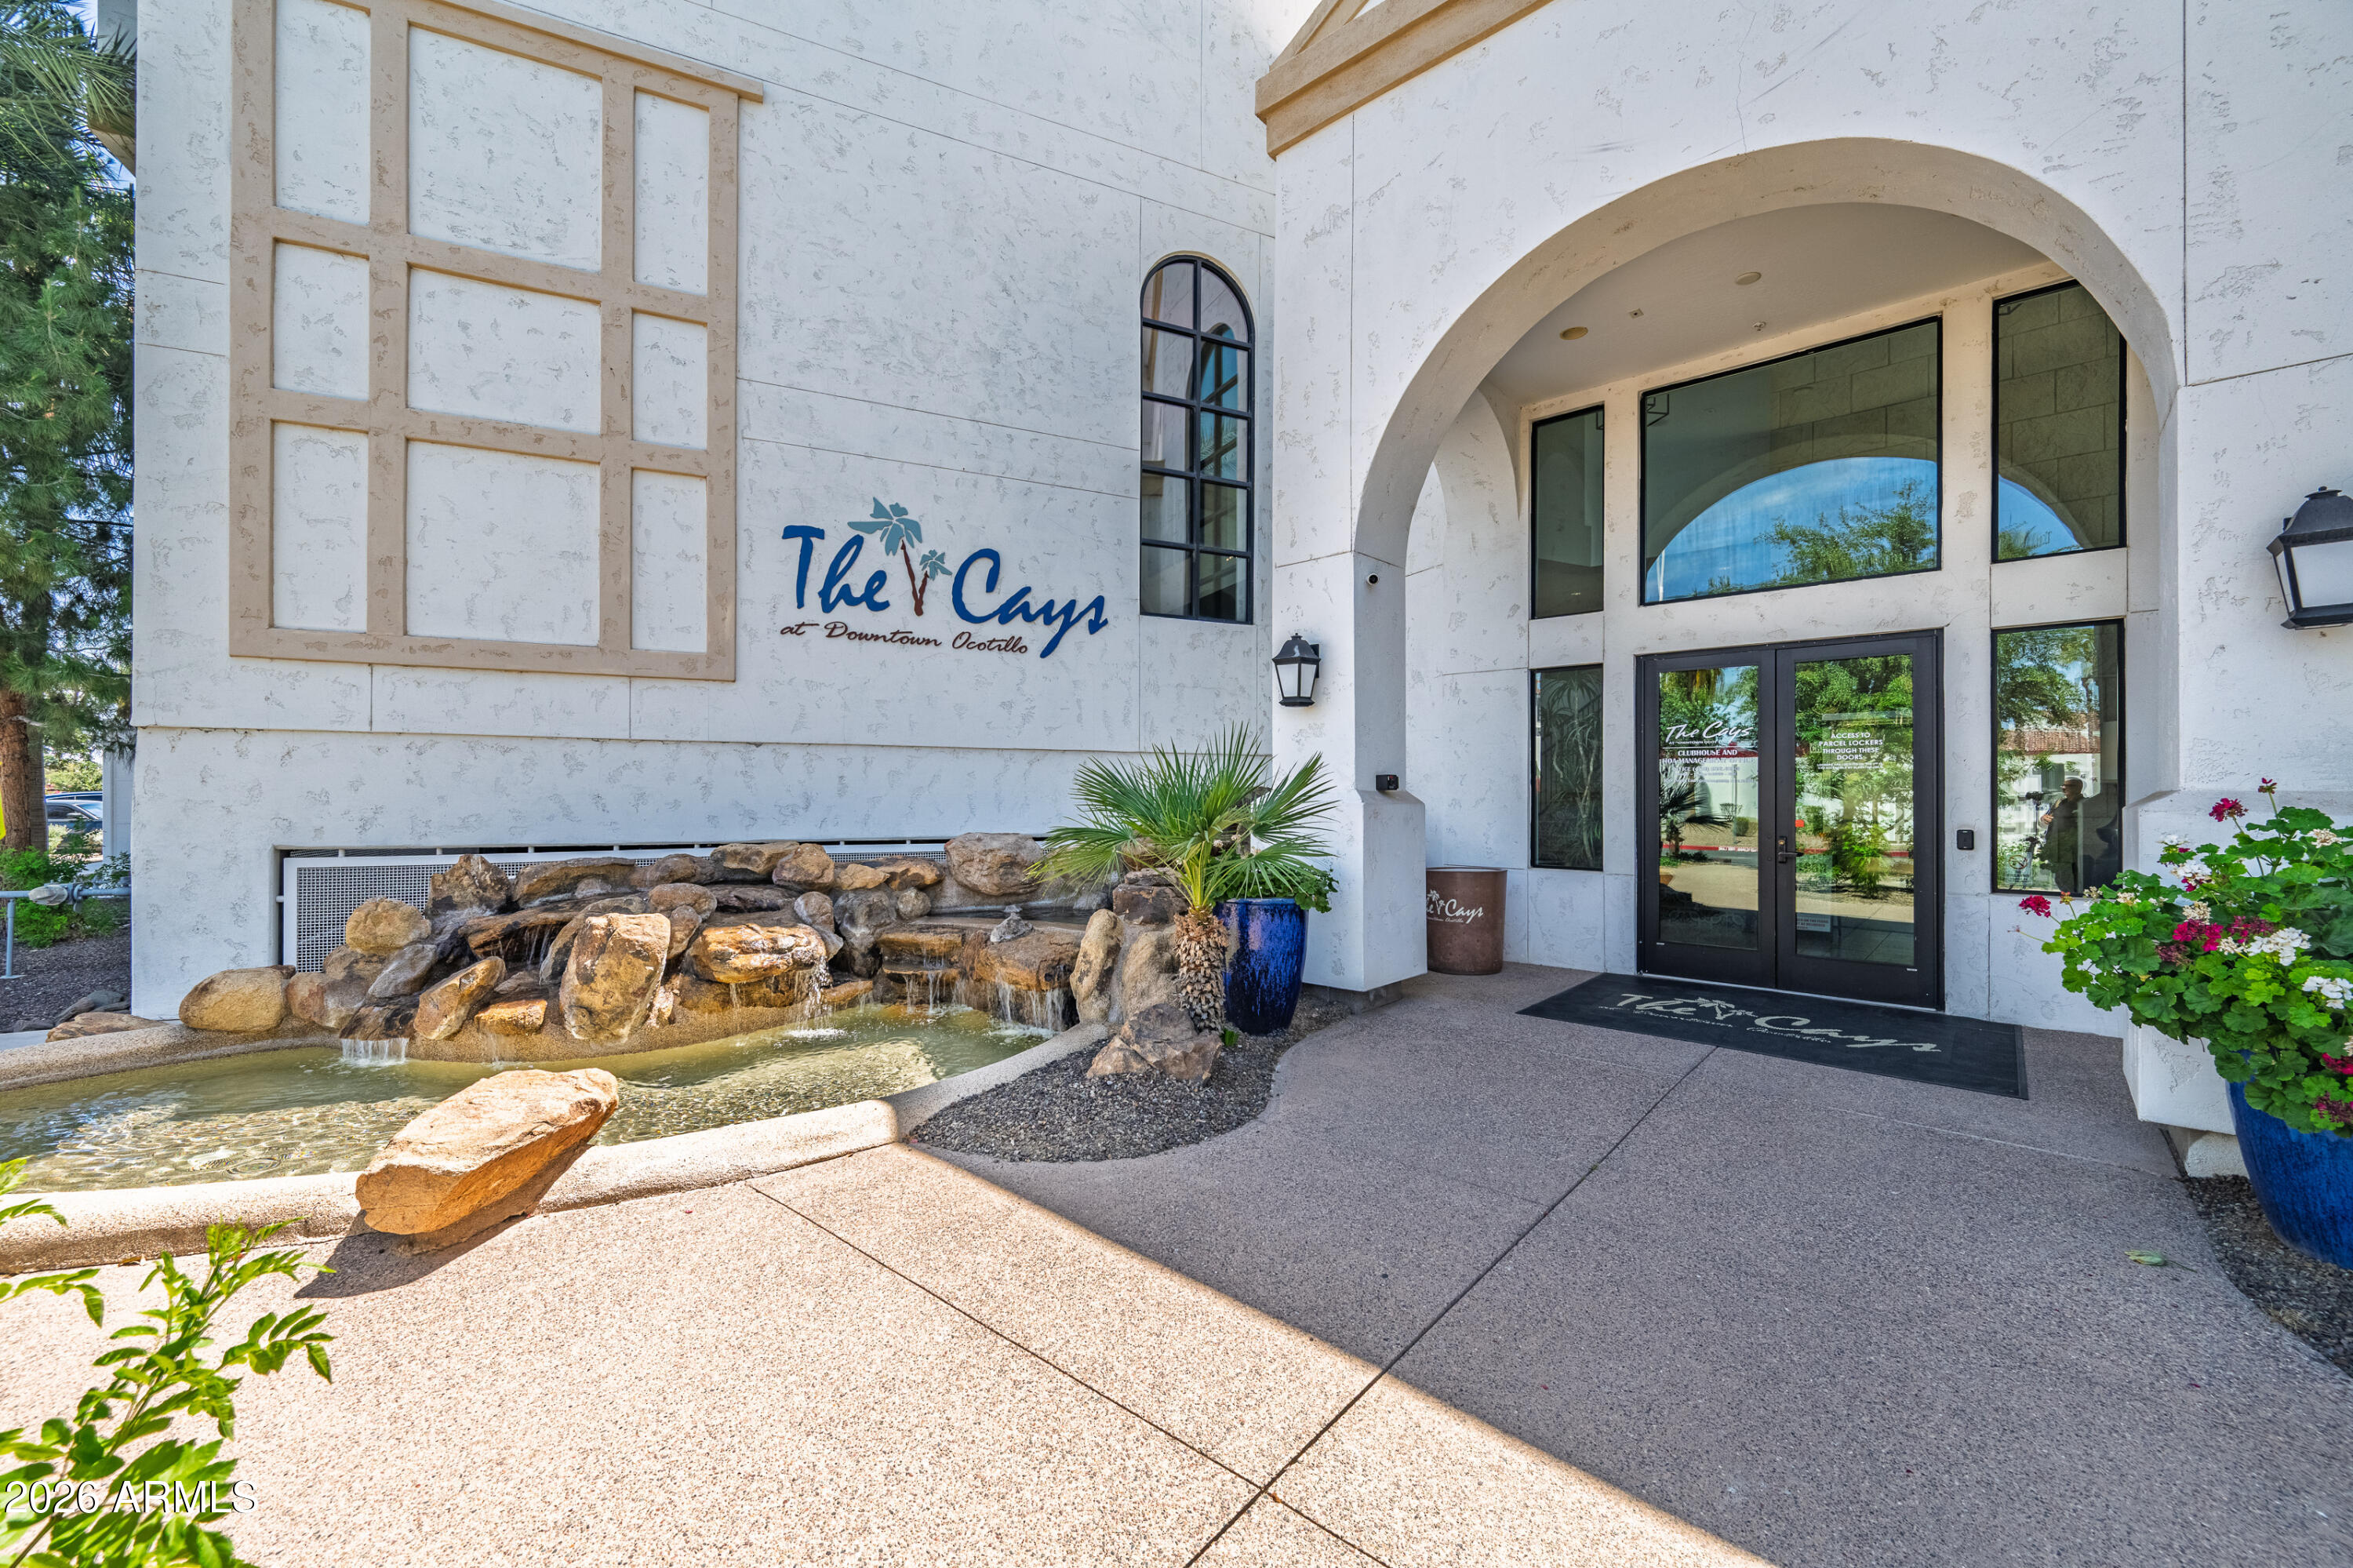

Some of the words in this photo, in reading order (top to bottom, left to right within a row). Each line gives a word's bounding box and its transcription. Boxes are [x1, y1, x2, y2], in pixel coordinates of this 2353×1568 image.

[782, 525, 890, 613] The
[951, 548, 1108, 658] Cays
[780, 621, 819, 637] at
[824, 620, 941, 647] Downtown
[951, 631, 1028, 654] Ocotillo
[1665, 723, 1700, 743] The
[1702, 721, 1755, 744] Cays
[1445, 898, 1483, 924] Cays
[1617, 993, 1697, 1015] The
[1754, 1016, 1942, 1053] Cays
